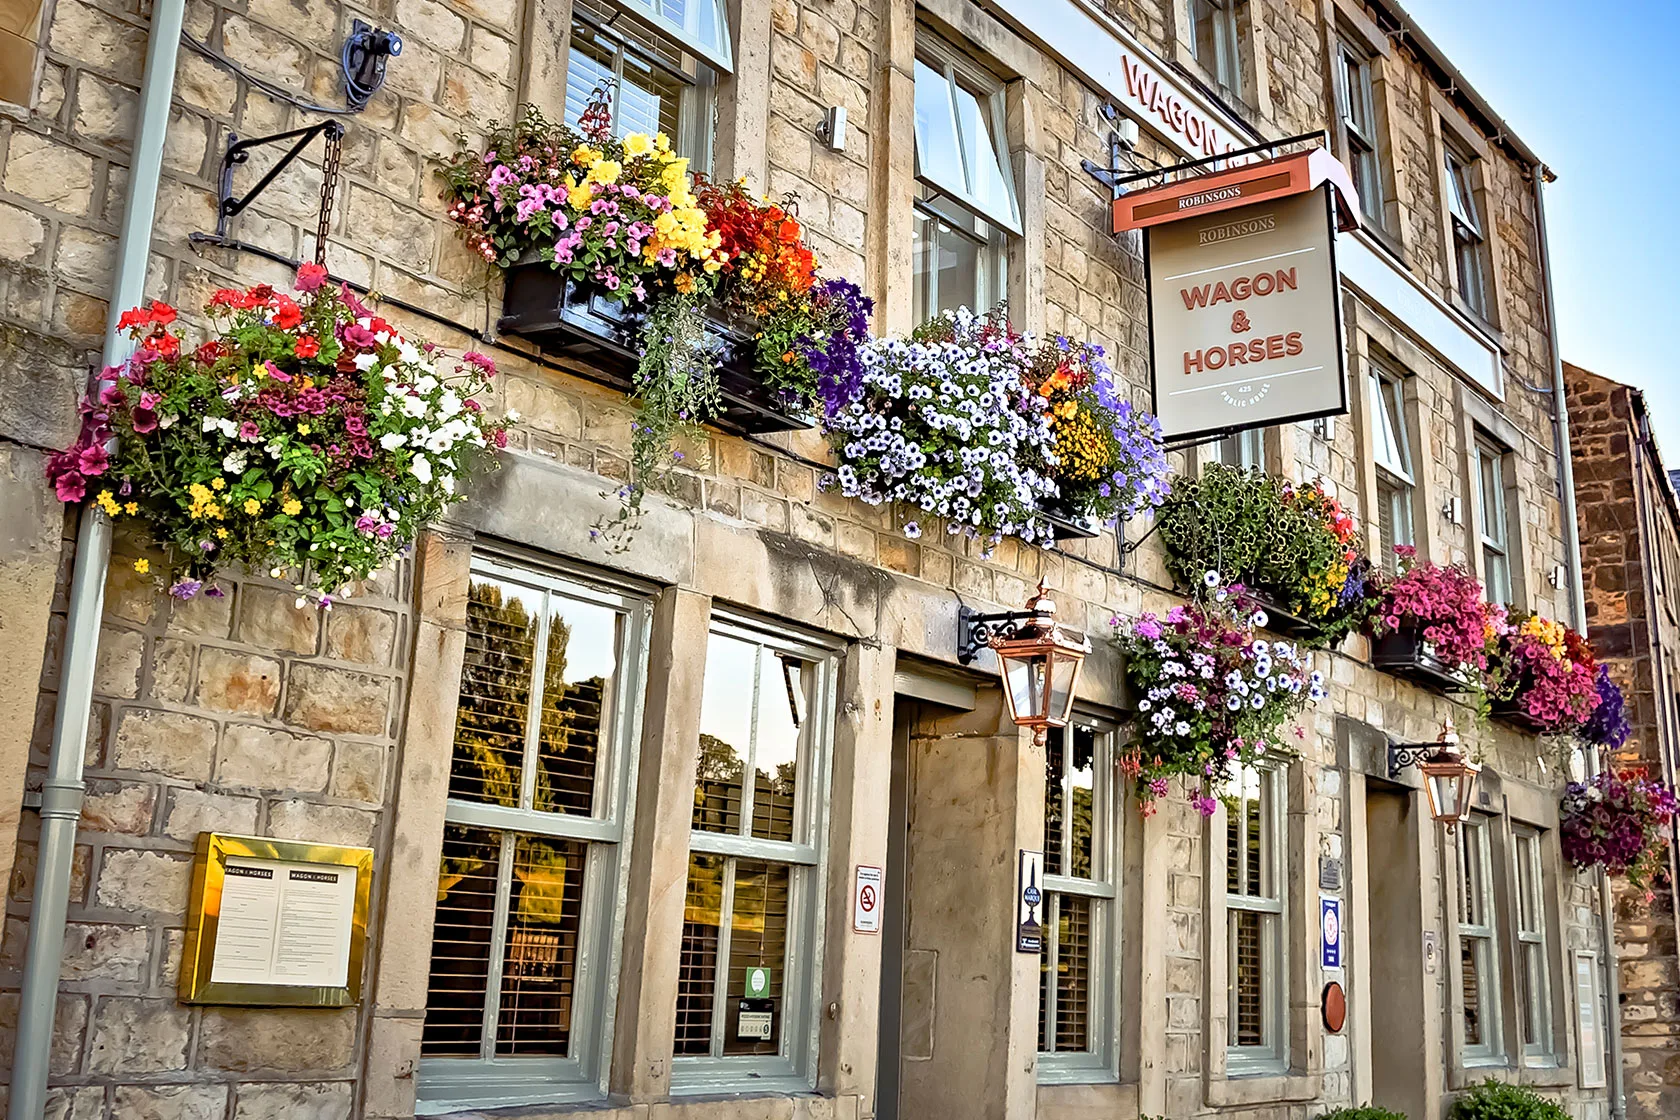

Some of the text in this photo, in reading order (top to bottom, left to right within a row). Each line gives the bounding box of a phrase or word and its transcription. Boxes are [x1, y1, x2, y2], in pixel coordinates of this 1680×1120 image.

[1120, 54, 1220, 157] WAGON
[1178, 186, 1242, 209] ROBINSONS
[1199, 216, 1276, 244] ROBINSONS
[1180, 267, 1298, 310] WAGON
[1231, 309, 1251, 333] &
[1183, 332, 1303, 374] HORSES
[1220, 383, 1271, 407] PUBLIC HOUSE
